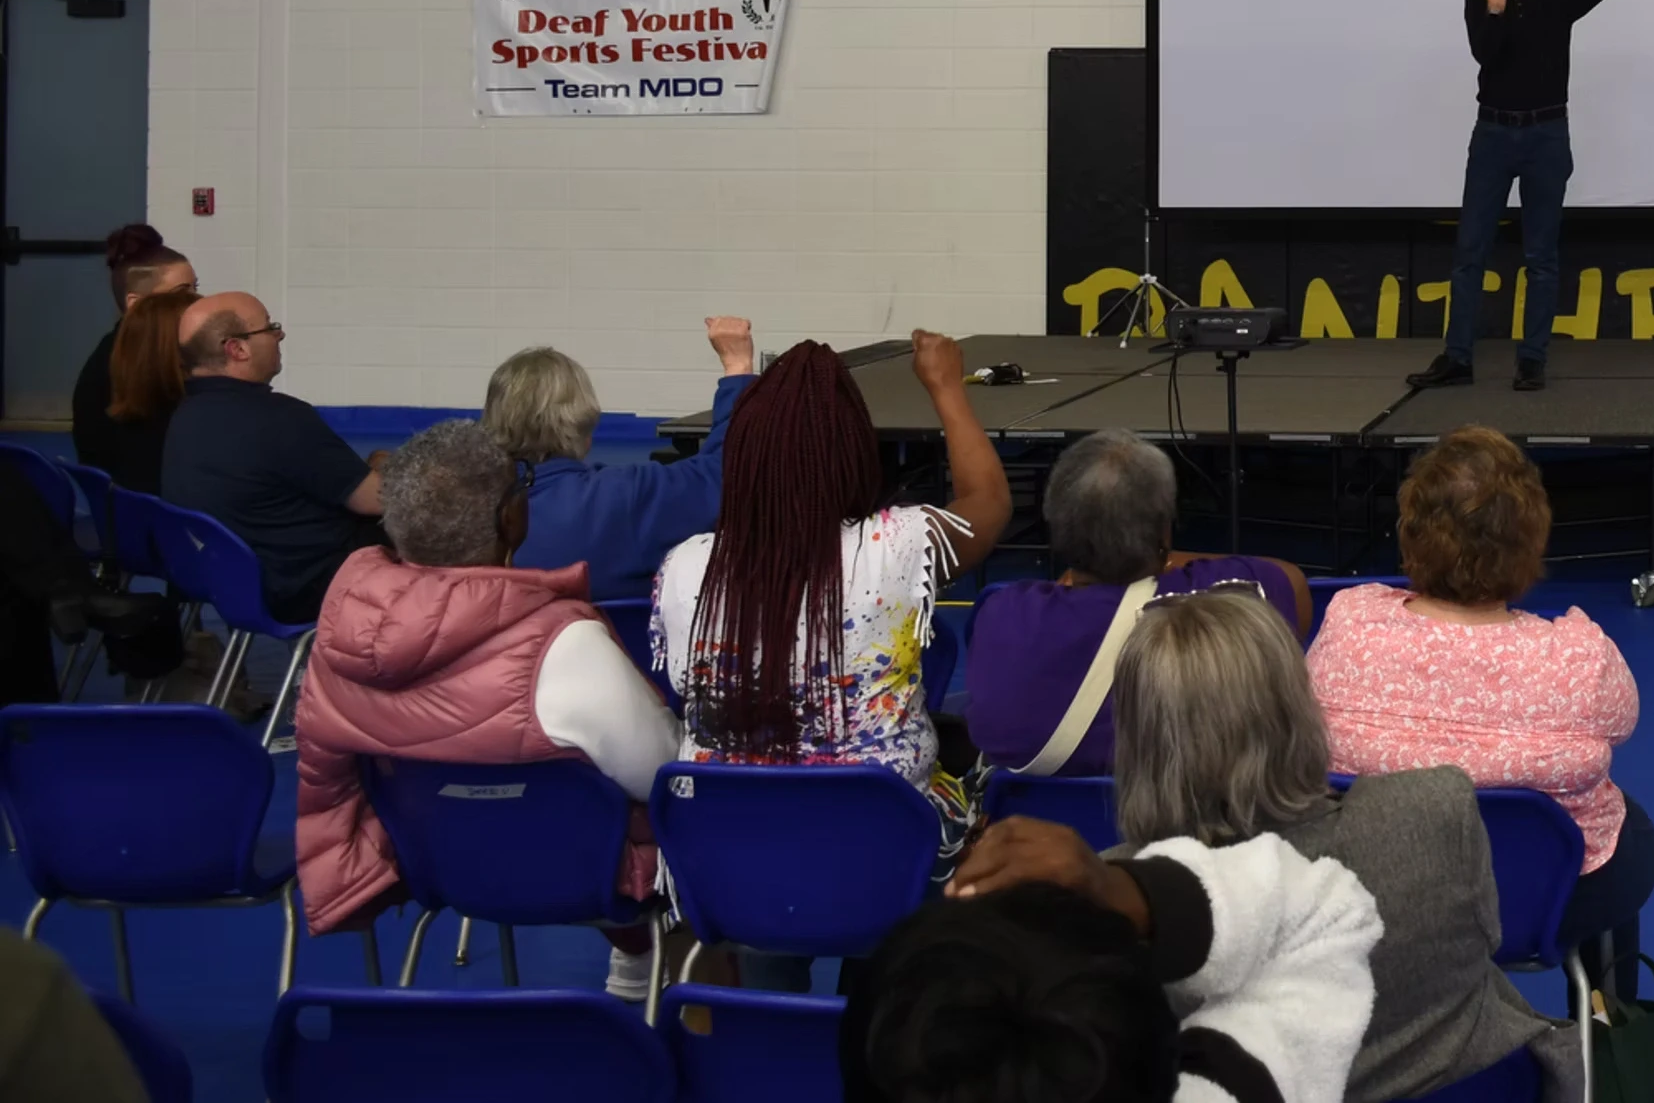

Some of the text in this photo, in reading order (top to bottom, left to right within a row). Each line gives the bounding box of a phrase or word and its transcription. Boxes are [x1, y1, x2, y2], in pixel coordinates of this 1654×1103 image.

[517, 6, 734, 38] Deaf Youth
[492, 36, 768, 68] Sports Festiva
[544, 77, 723, 99] Team MDO
